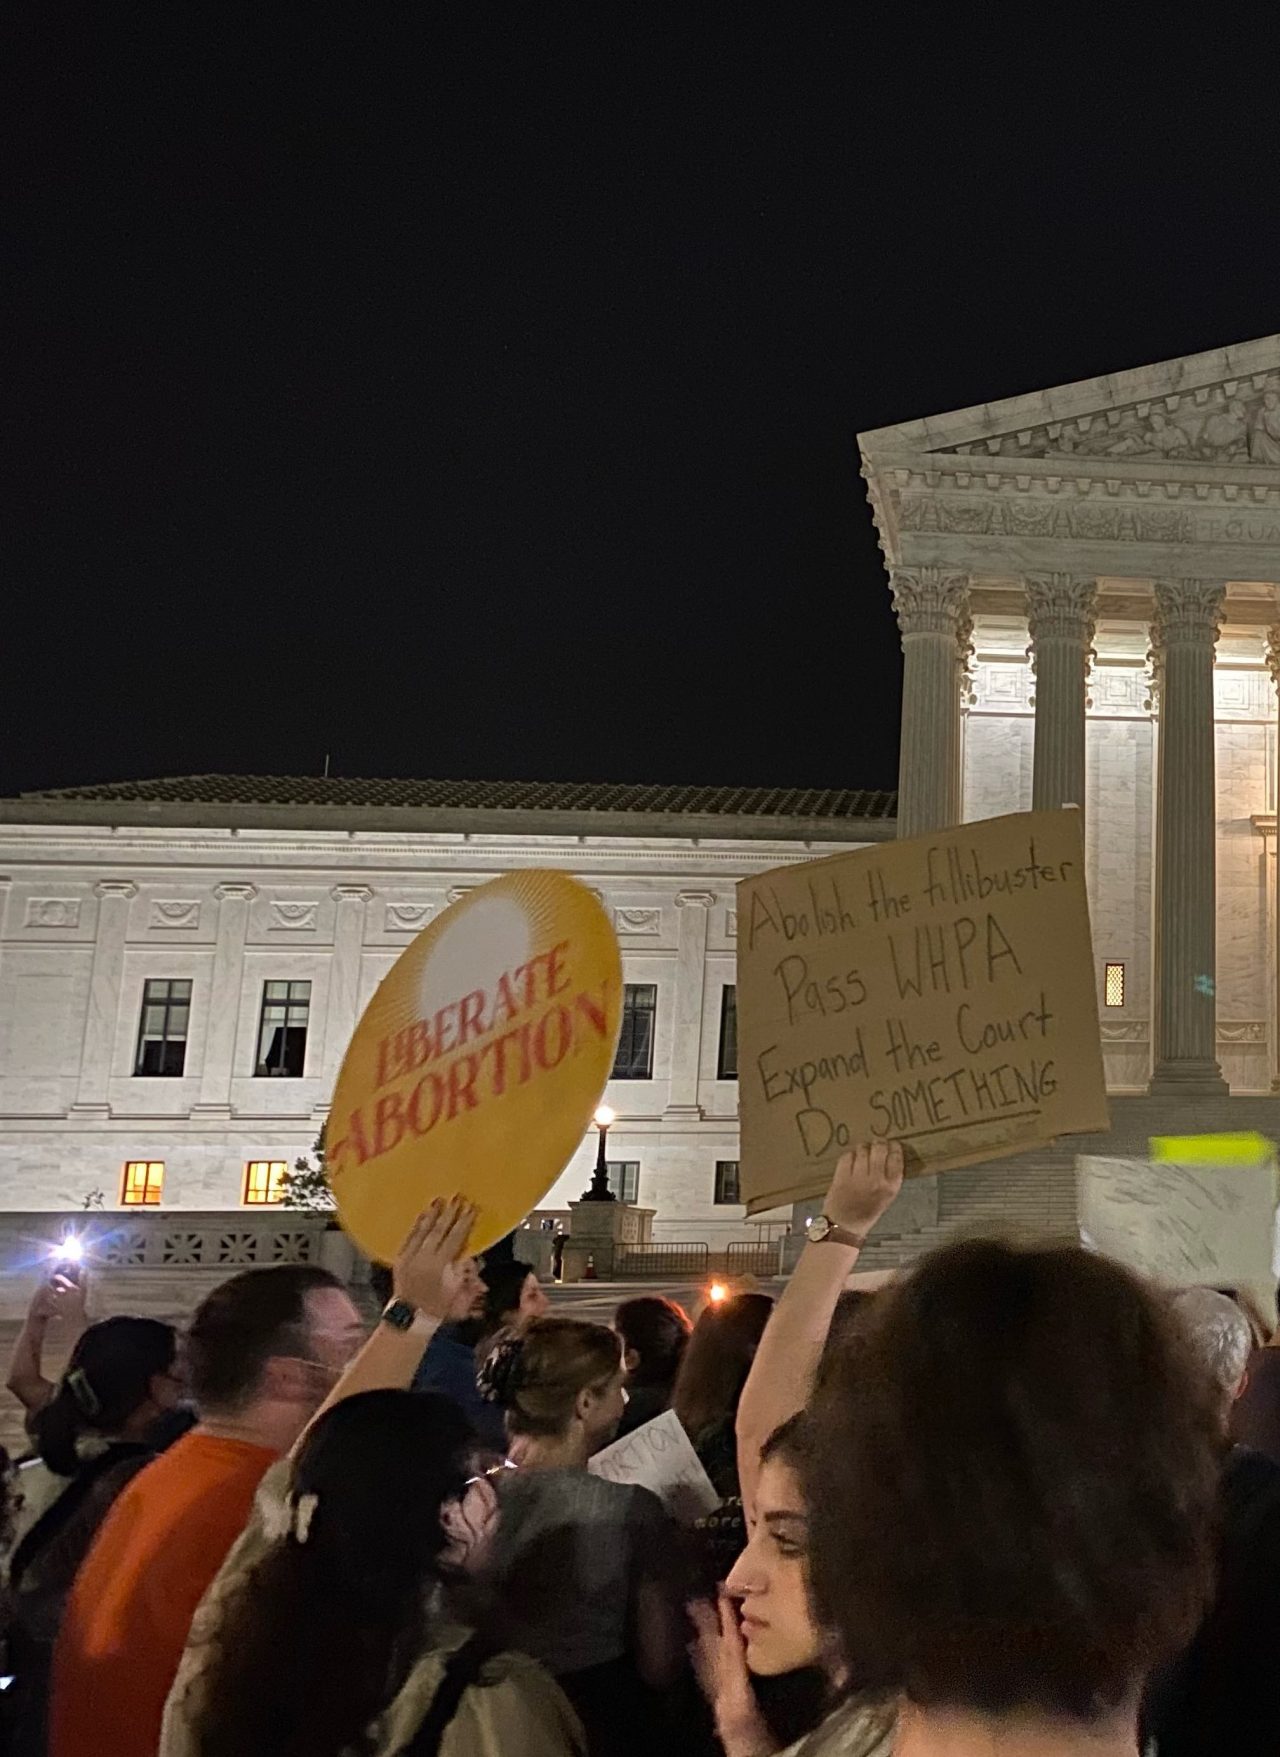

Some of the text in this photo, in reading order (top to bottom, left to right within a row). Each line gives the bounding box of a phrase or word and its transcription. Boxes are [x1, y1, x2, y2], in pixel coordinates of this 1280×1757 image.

[748, 882, 855, 951] Abolish
[867, 869, 912, 923] the
[373, 940, 574, 1089] LIBERATE
[773, 912, 1023, 1026] Pass WHPA
[327, 978, 611, 1176] ABORTION
[756, 991, 1055, 1106] Expand the Court
[795, 1060, 1059, 1158] Do SOMETHING
